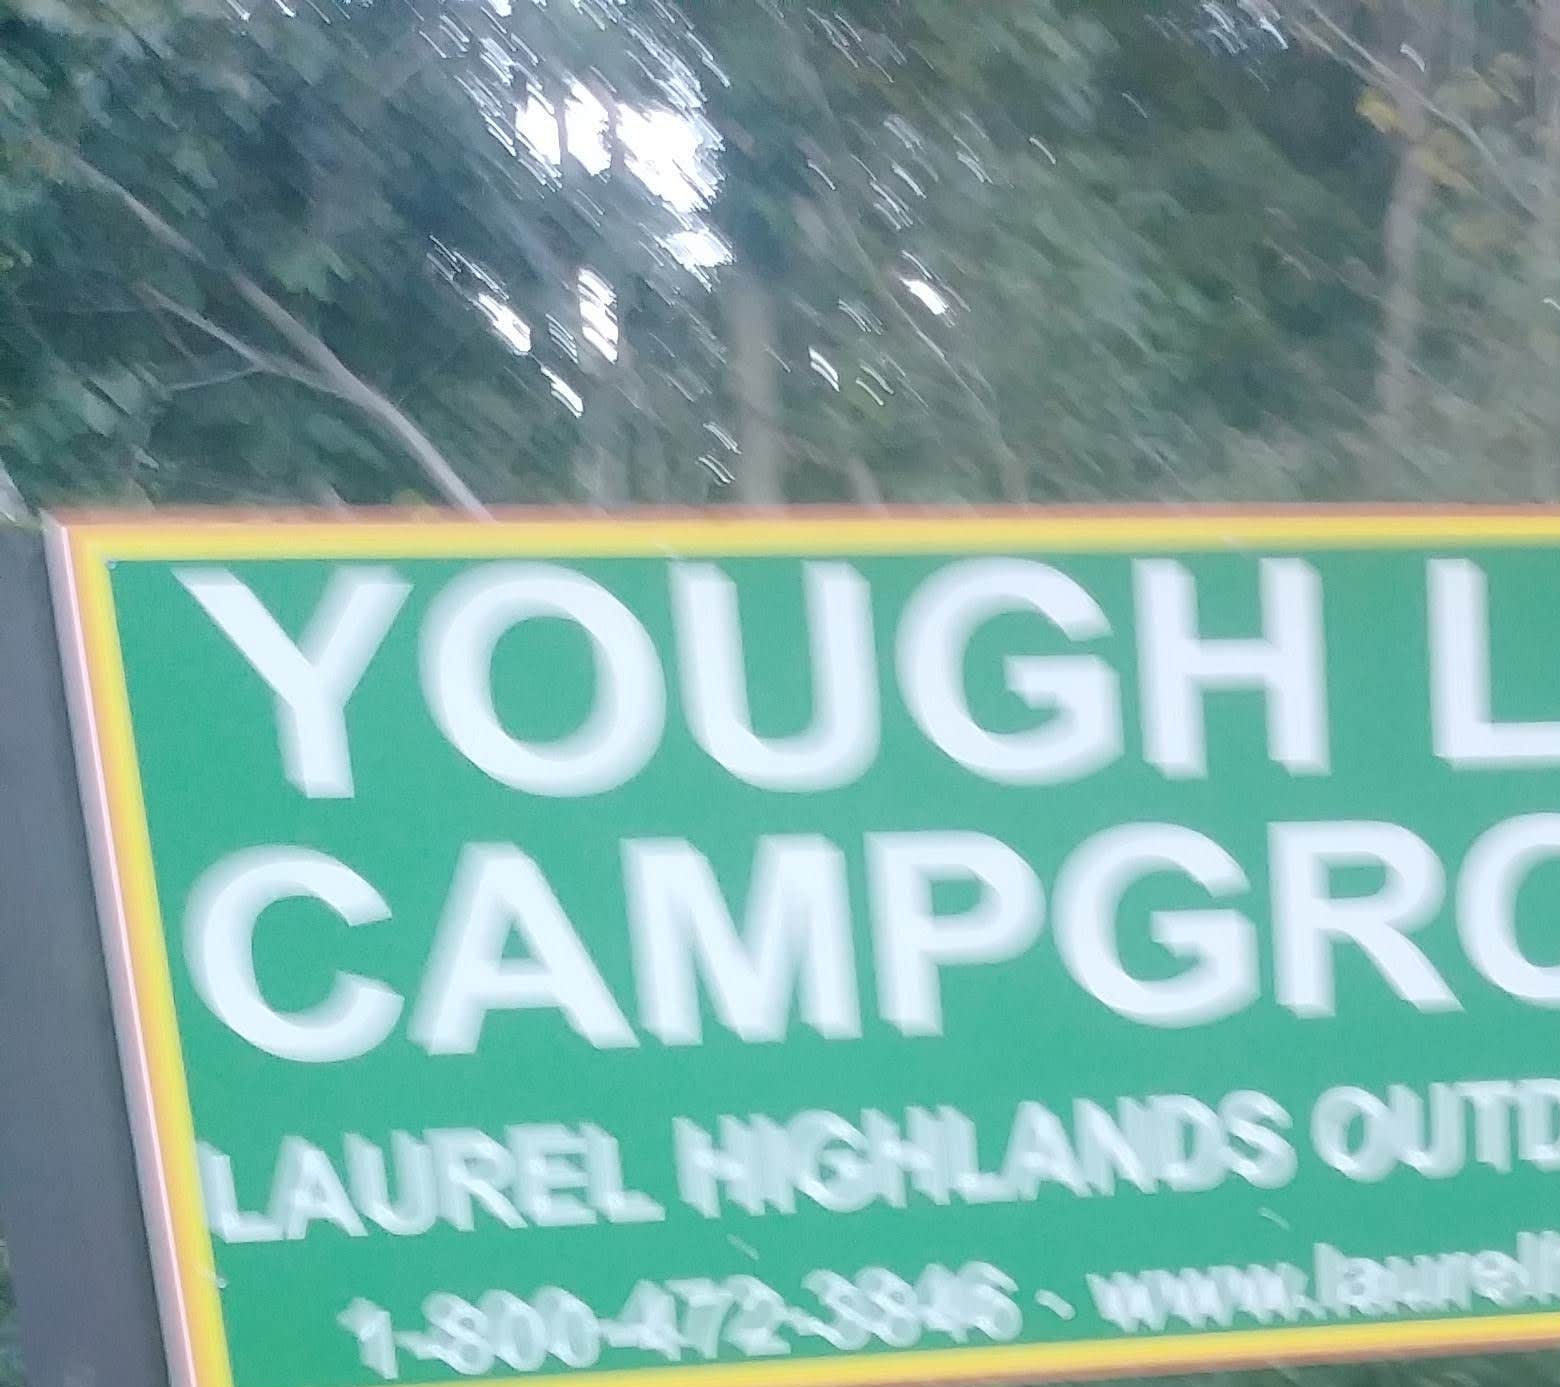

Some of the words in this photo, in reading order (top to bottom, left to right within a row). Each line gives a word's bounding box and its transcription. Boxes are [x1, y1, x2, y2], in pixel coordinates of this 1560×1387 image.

[171, 555, 1332, 799] YOUGH
[199, 1121, 666, 1244] LAUREL
[672, 1090, 1298, 1219] HIGHLANDS
[336, 1261, 1023, 1380] 1-800-472-3846
